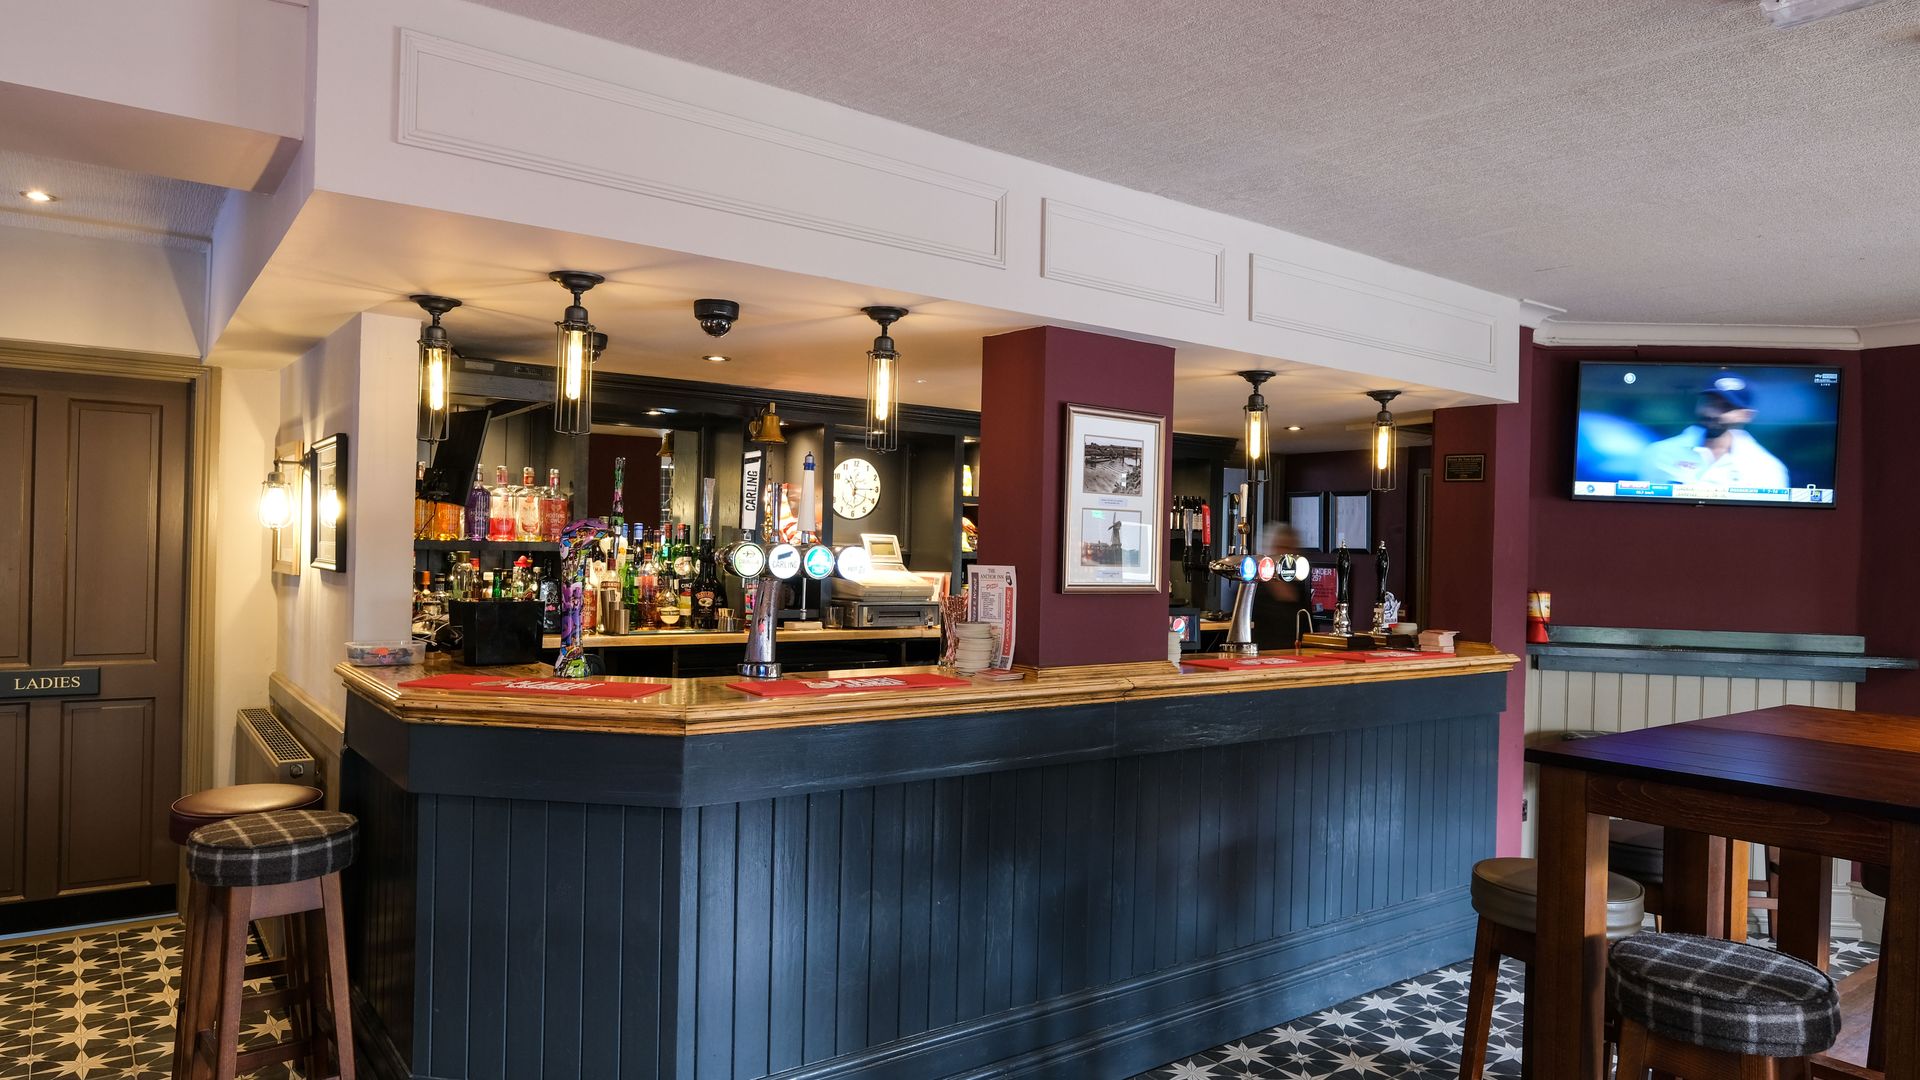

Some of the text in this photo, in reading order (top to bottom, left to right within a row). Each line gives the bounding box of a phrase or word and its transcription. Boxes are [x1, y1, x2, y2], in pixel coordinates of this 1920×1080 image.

[745, 470, 758, 511] CARLING
[772, 560, 798, 568] CARLING
[14, 676, 80, 690] LADIES
